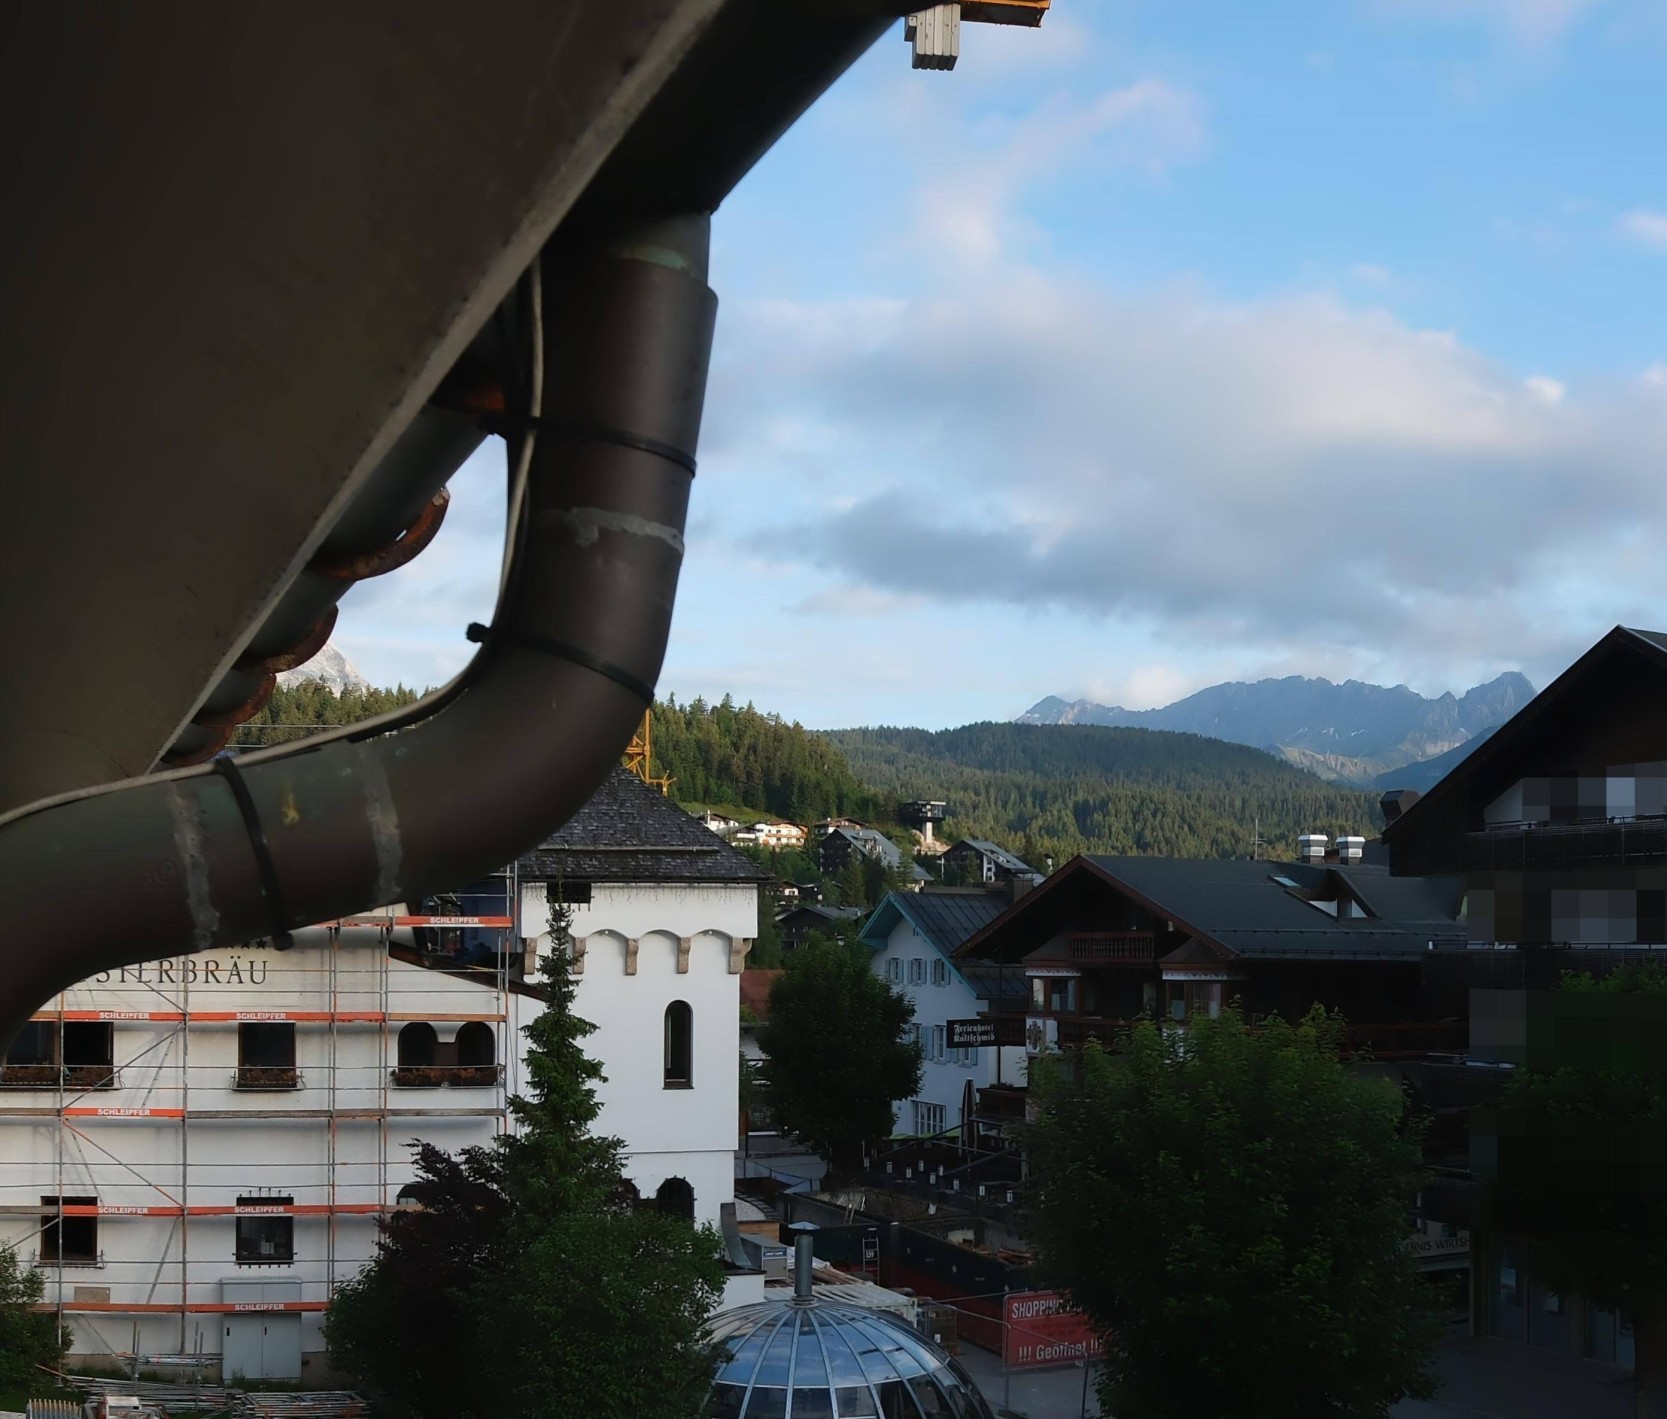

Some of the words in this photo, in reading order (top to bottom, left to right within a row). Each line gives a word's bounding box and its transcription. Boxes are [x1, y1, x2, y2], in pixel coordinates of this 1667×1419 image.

[82, 956, 268, 984] STERBRÄU
[99, 1012, 150, 1020] SCHLEIPFER
[236, 1012, 286, 1020] SCHLEIPFER
[98, 1108, 150, 1116] SCHLEIPFER
